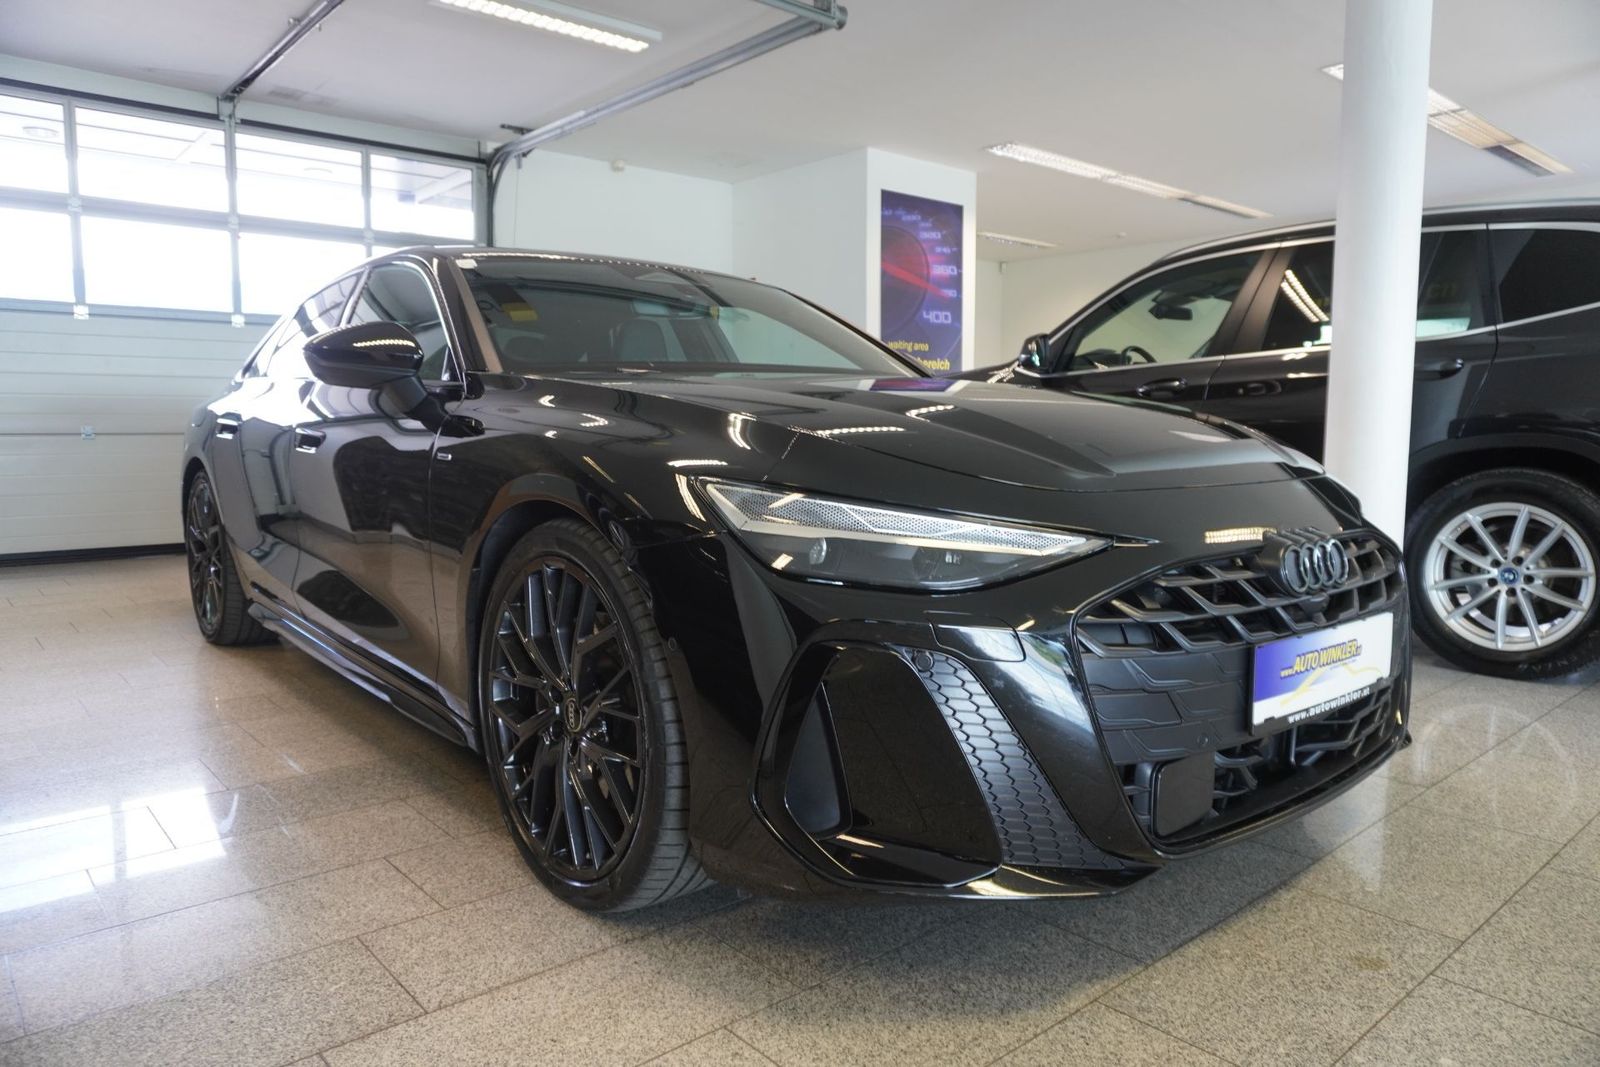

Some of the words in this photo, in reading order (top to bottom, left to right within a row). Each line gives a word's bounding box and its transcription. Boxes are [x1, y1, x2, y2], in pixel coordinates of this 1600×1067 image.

[923, 311, 952, 324] 400
[888, 340, 913, 353] waiting
[913, 343, 930, 352] area
